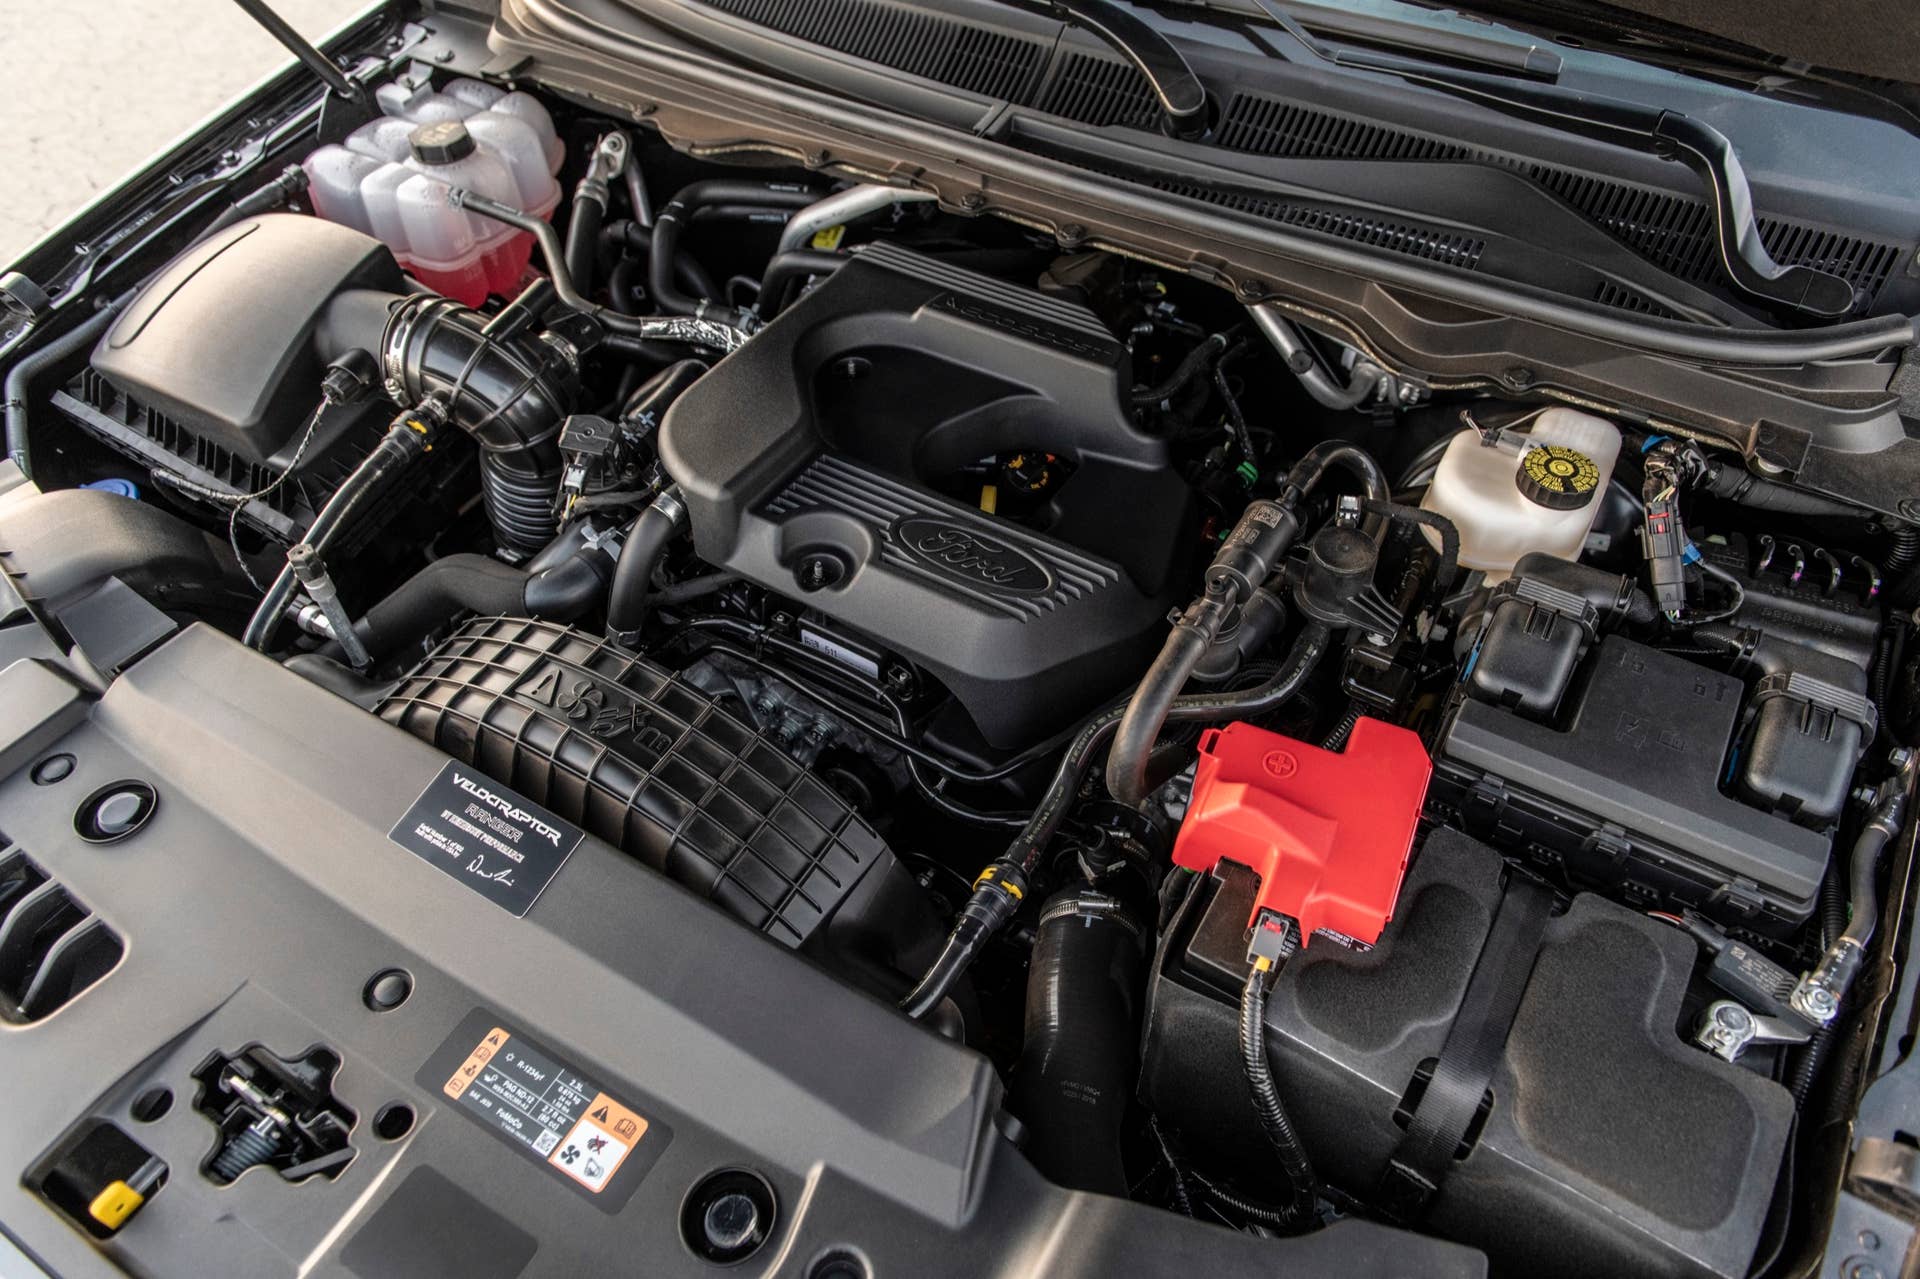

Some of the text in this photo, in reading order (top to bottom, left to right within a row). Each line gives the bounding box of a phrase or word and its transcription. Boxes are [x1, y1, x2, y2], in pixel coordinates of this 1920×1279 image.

[918, 529, 1027, 583] Ford
[453, 773, 562, 847] VELOCIRAPTOR
[465, 803, 523, 843] RANGER
[516, 1060, 546, 1081] R-1234yf
[496, 1107, 523, 1130] FoMoCo
